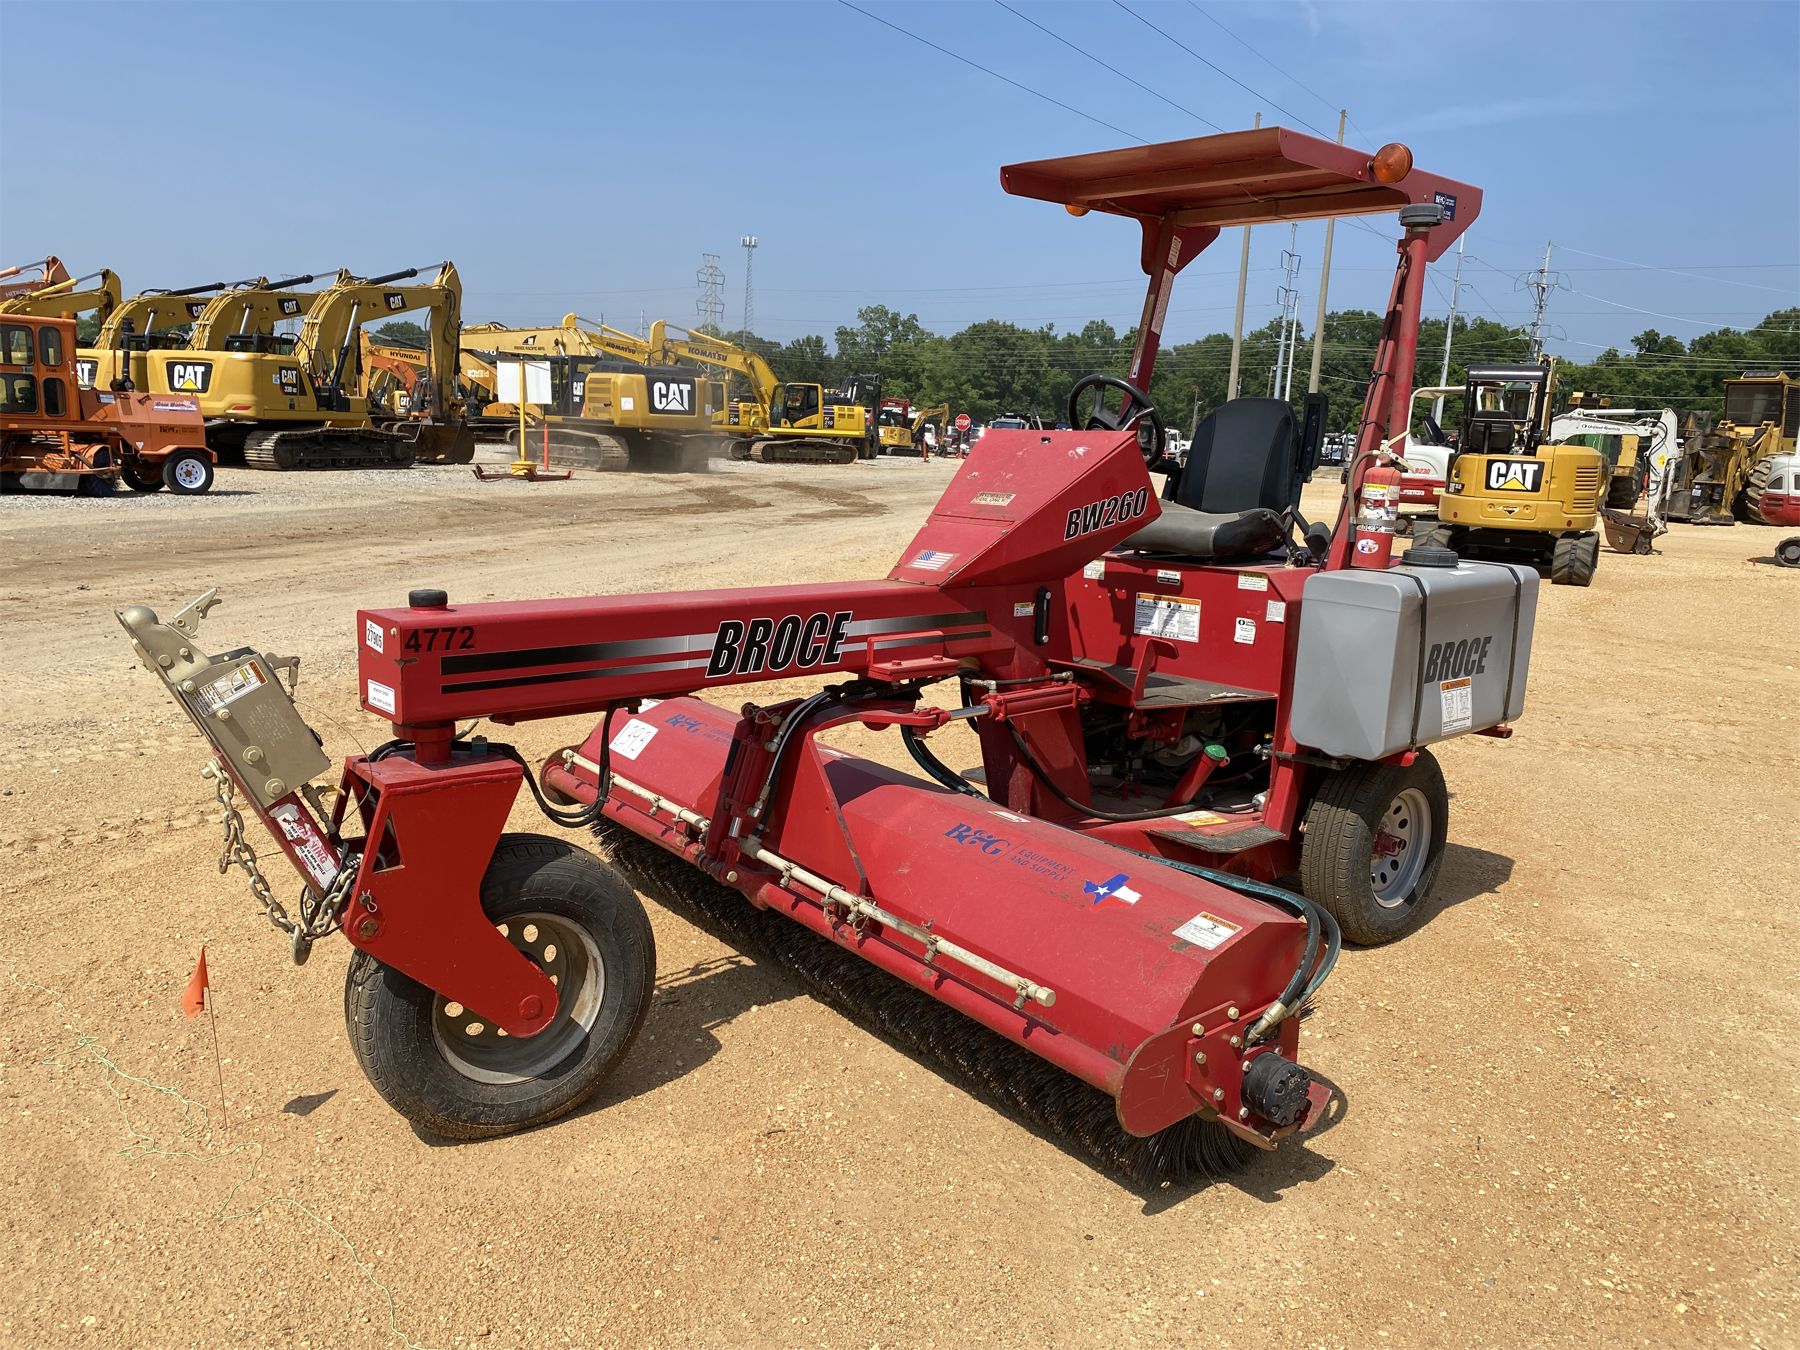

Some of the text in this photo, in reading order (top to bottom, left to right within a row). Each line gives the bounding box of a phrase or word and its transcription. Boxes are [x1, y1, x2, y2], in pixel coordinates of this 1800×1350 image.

[284, 301, 297, 313] CAT
[390, 295, 402, 309] CAT
[390, 350, 420, 361] HYUNDAI
[606, 341, 636, 354] KOMATSU
[688, 346, 728, 362] KOMATSU
[77, 362, 91, 385] AT
[173, 364, 205, 390] CAT
[281, 369, 297, 383] CAT
[573, 382, 583, 395] CAT
[653, 381, 691, 411] CAT
[1490, 461, 1538, 491] CAT
[1064, 486, 1148, 541] BW260
[367, 627, 382, 649] 27905
[404, 626, 475, 653] 4772
[705, 611, 854, 678] BROCE
[1424, 636, 1492, 684] BROCE
[1009, 856, 1068, 881] AND SUPPLY
[1018, 849, 1076, 874] EQUIPMENT
